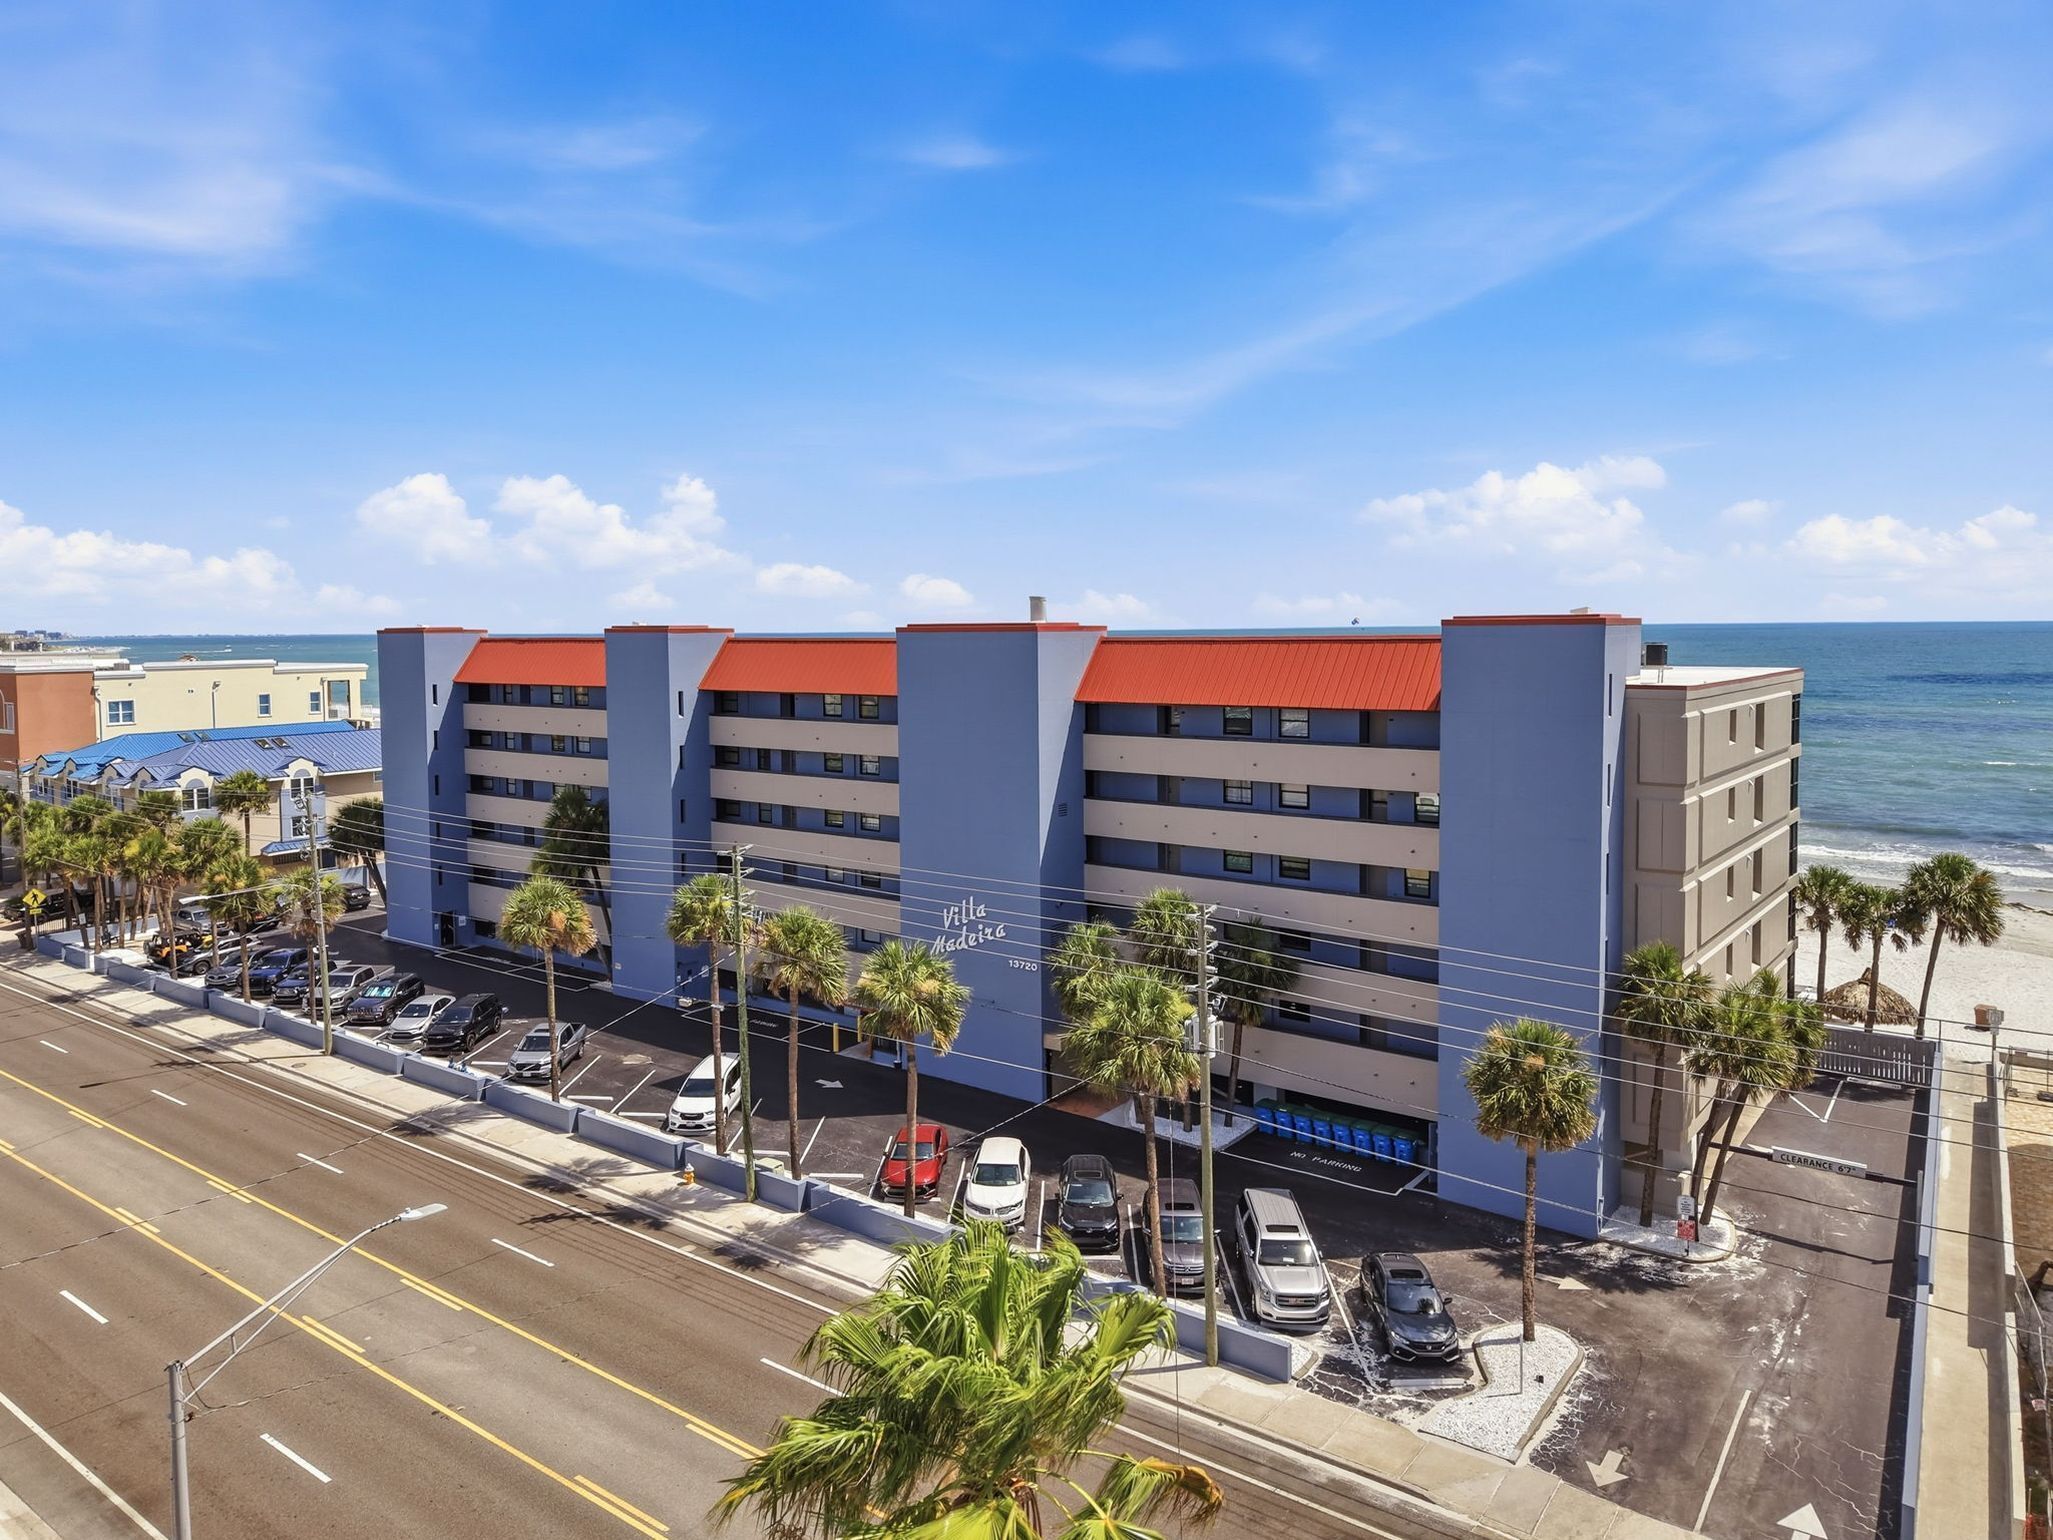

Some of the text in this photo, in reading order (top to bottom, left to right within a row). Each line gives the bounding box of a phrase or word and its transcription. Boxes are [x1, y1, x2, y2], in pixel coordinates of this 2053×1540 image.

[943, 896, 987, 929] Villa
[930, 924, 1006, 955] Madeira
[1009, 960, 1038, 971] 13720
[1290, 1151, 1362, 1172] NO PARKING
[1780, 1153, 1833, 1170] CLEARANCE
